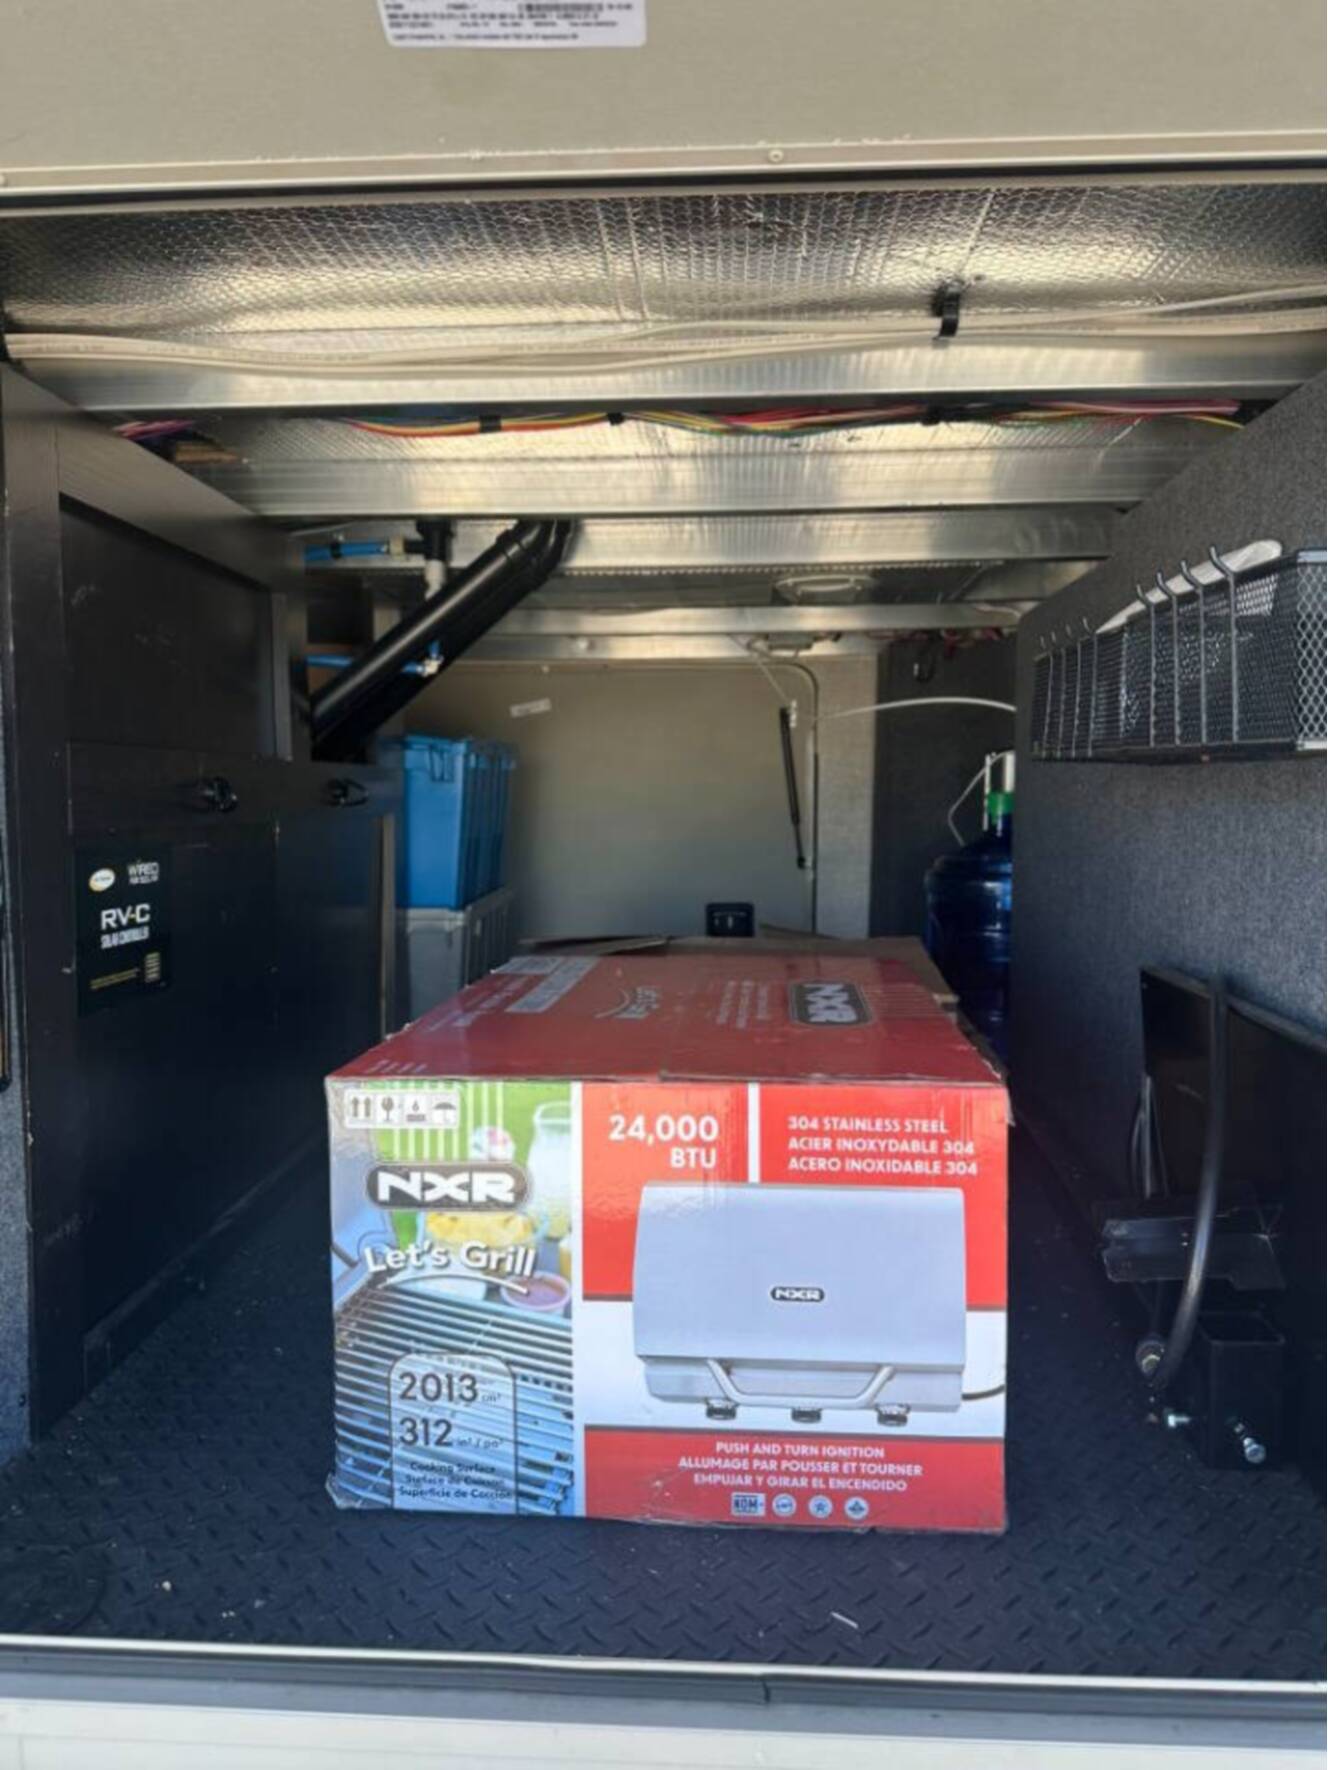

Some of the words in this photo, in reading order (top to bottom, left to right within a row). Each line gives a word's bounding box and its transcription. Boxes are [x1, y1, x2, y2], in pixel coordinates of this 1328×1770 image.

[101, 903, 150, 930] RV-C
[608, 1113, 719, 1146] 24,000
[788, 1116, 819, 1130] 304
[823, 1116, 900, 1132] STAINLESS
[904, 1119, 948, 1133] STEEL
[788, 1137, 833, 1151] ACIER
[836, 1138, 938, 1154] INOXYDABLE
[943, 1140, 975, 1155] 304
[670, 1147, 717, 1169] BTU
[788, 1158, 841, 1172] ACERO
[845, 1158, 941, 1174] INOXIDABLE
[946, 1161, 978, 1175] 304
[377, 1171, 515, 1203] NXR
[363, 1240, 449, 1273] Let's
[460, 1240, 536, 1276] Grill
[775, 1290, 820, 1300] NXR
[399, 1372, 478, 1402] 2013
[399, 1417, 453, 1447] 312
[716, 1441, 749, 1455] PUSH
[753, 1442, 782, 1456] AND
[785, 1443, 818, 1457] TURN
[822, 1445, 885, 1459] IGNITION
[678, 1457, 750, 1471] ALLUMAGE
[753, 1459, 777, 1472] PAR
[781, 1460, 838, 1474] POUSSER
[842, 1462, 858, 1475] ET
[860, 1462, 923, 1476] TOURNER
[694, 1474, 752, 1487] EMPUJAR
[756, 1475, 764, 1487] Y
[767, 1475, 808, 1489] GIRAR
[812, 1476, 826, 1489] EL
[829, 1477, 908, 1491] ENCENDIDO
